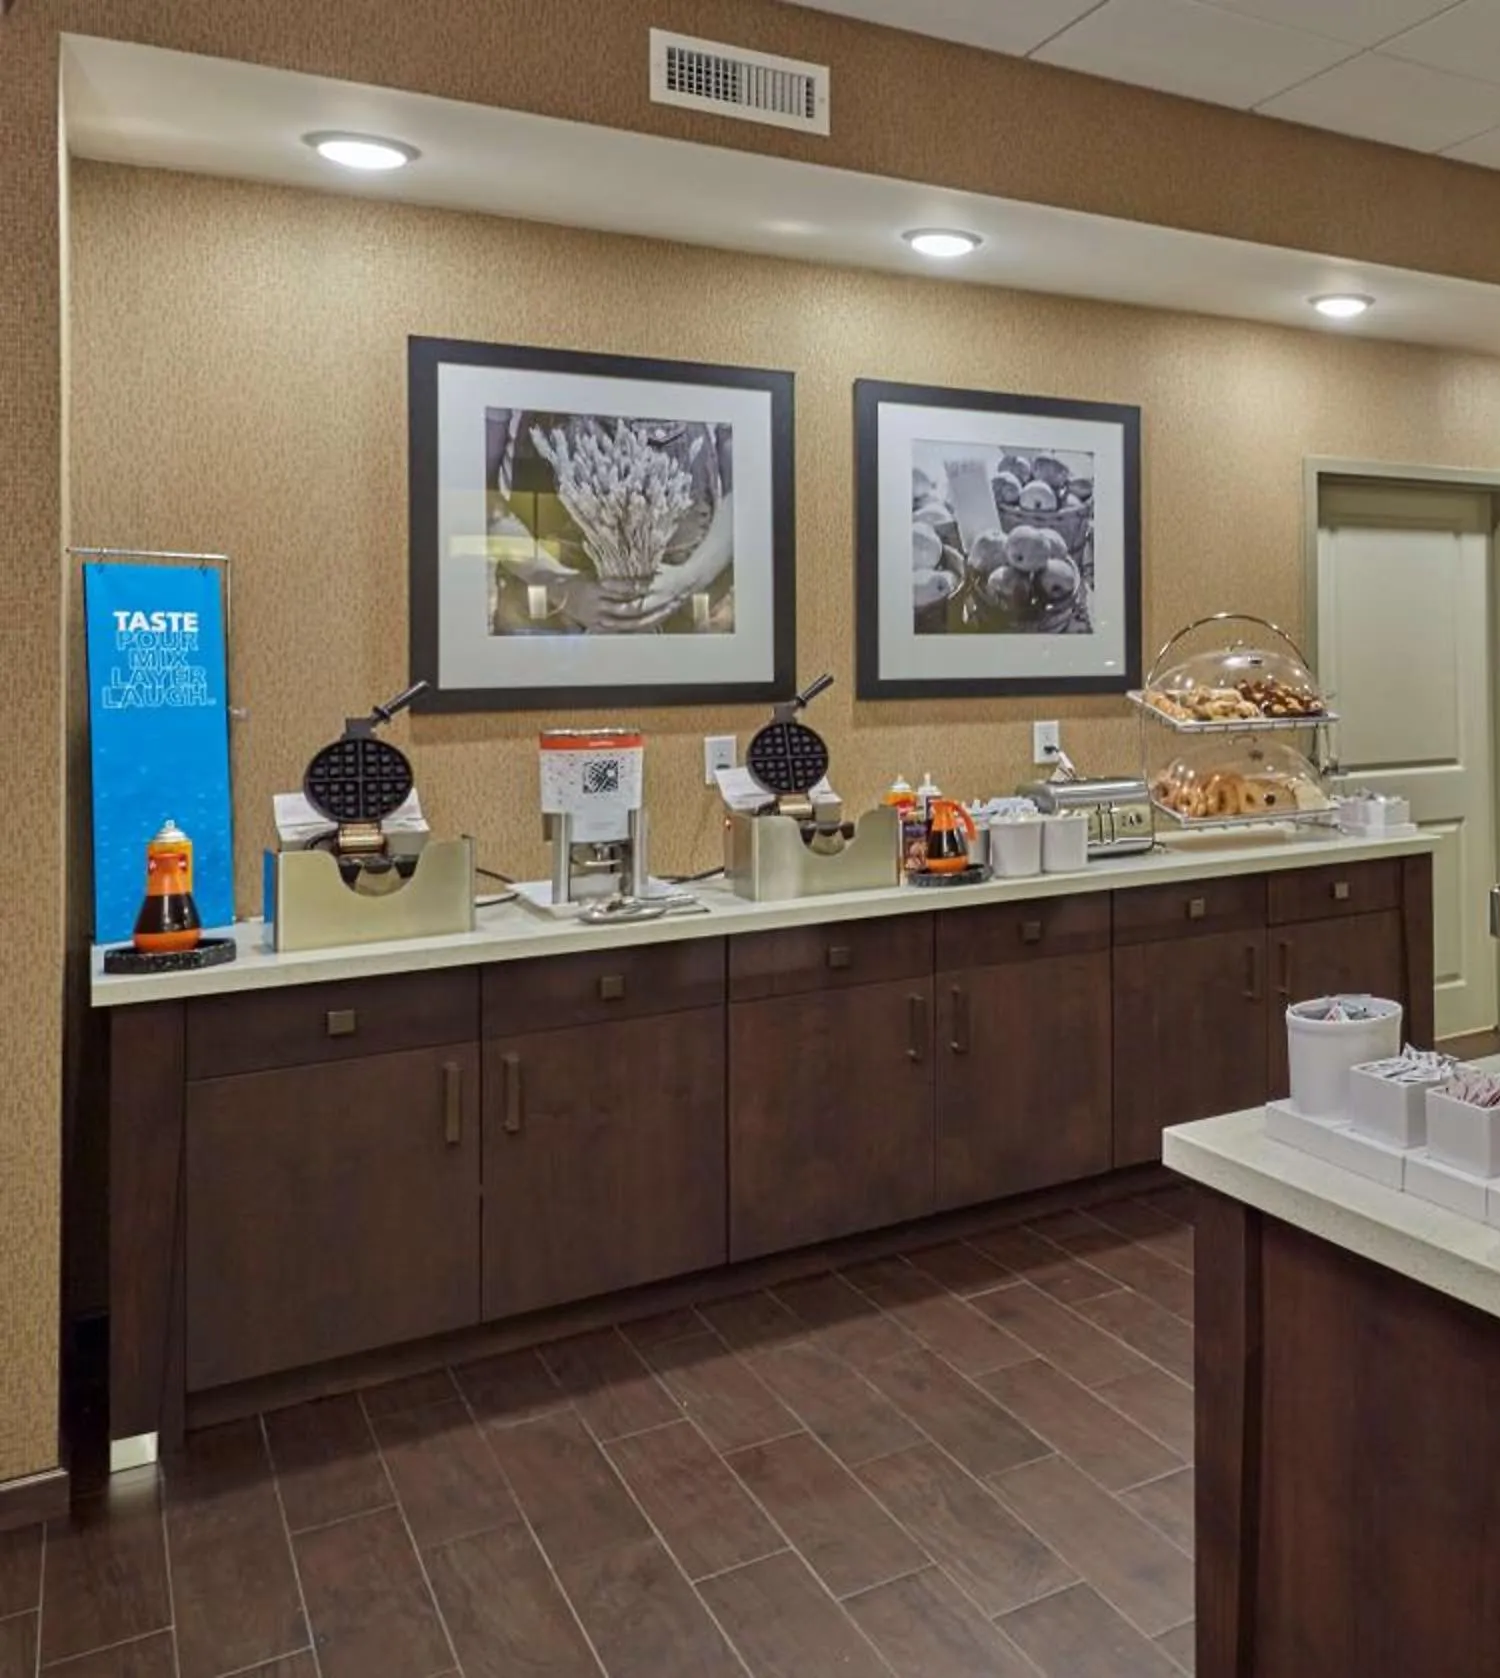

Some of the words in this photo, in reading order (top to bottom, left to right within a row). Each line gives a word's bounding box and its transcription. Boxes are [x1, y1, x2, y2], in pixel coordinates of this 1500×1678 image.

[113, 611, 199, 632] TASTE
[116, 631, 199, 651] POUR
[129, 650, 189, 670] MIX
[111, 667, 208, 689] LAYER
